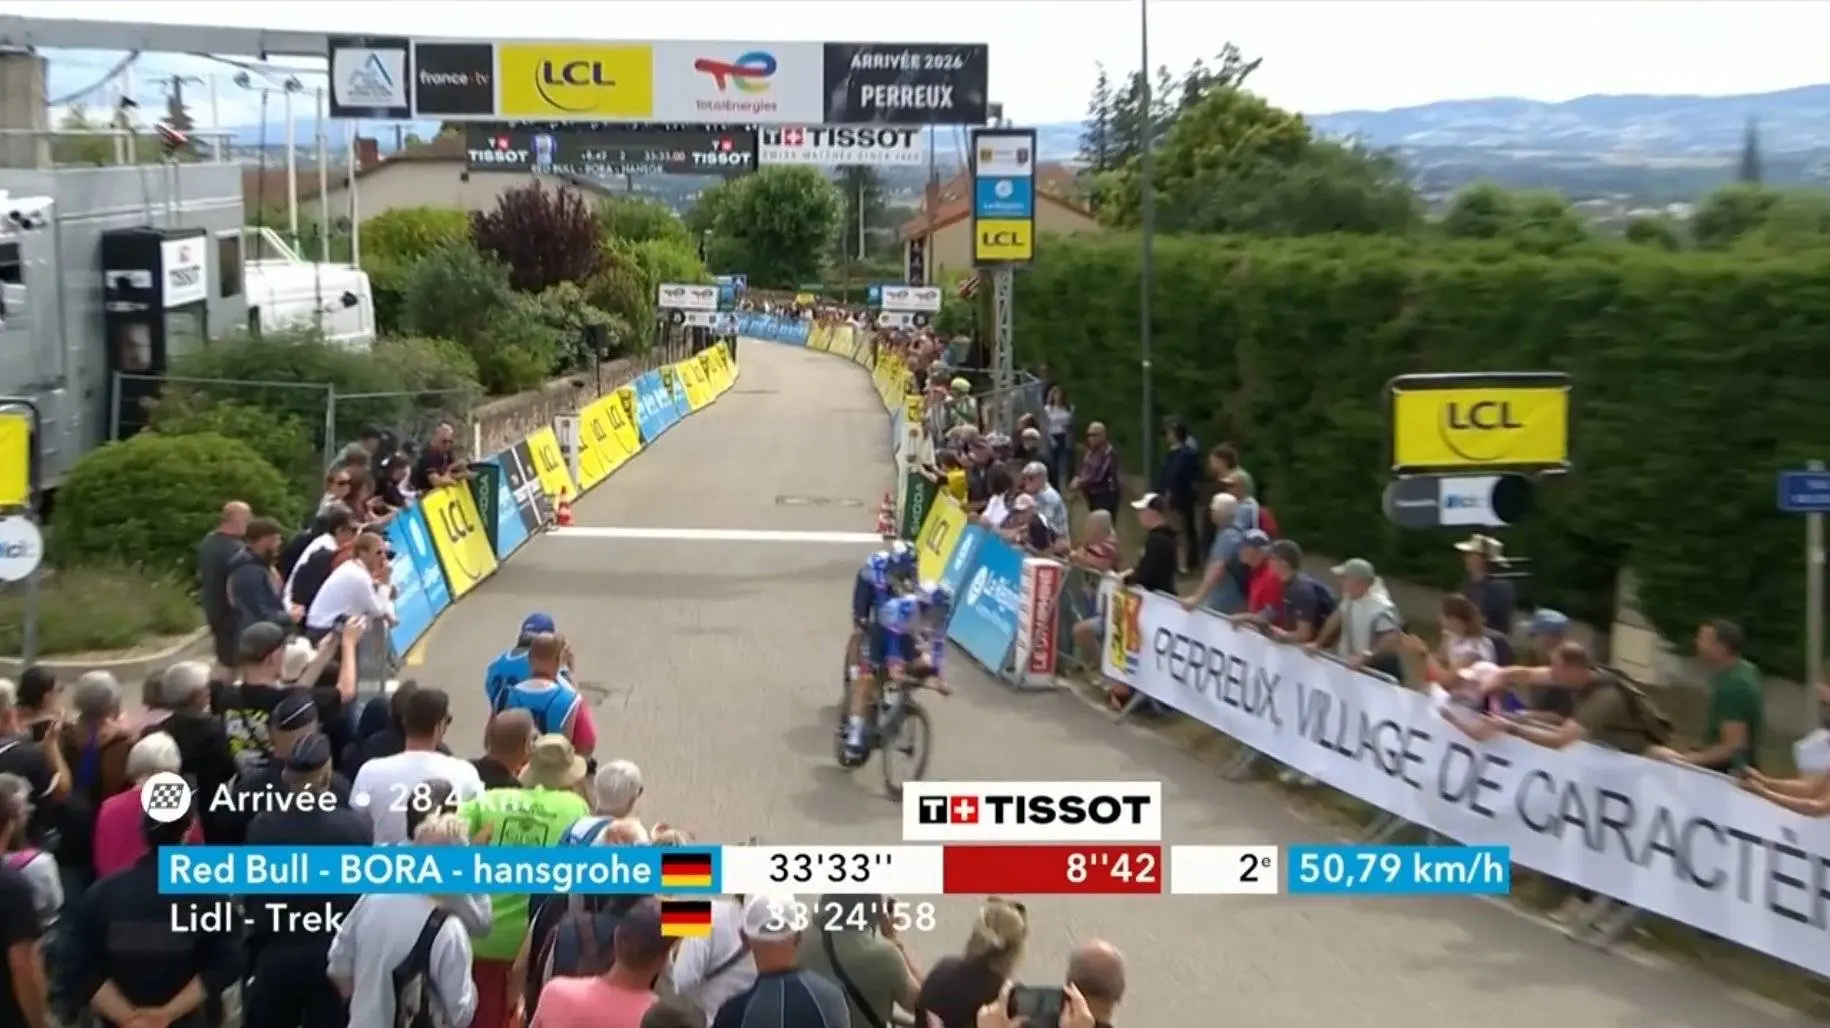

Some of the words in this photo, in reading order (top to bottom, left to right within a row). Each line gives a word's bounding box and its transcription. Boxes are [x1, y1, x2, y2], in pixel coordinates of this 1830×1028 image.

[851, 53, 920, 69] ARRIVÉE
[924, 54, 963, 69] 2026
[543, 60, 617, 87] LCL
[861, 84, 954, 108] PERREUX
[696, 100, 777, 114] TotalEnergies
[806, 127, 919, 148] TISSOT
[468, 151, 528, 163] TISSOT
[692, 152, 751, 165] TISSOT
[983, 231, 1025, 247] LCL
[1447, 402, 1524, 430] LCL
[438, 497, 475, 544] LCL
[1154, 626, 1284, 735] PERREUX,
[1296, 682, 1431, 790] VILLAGE
[1437, 742, 1513, 818] DE
